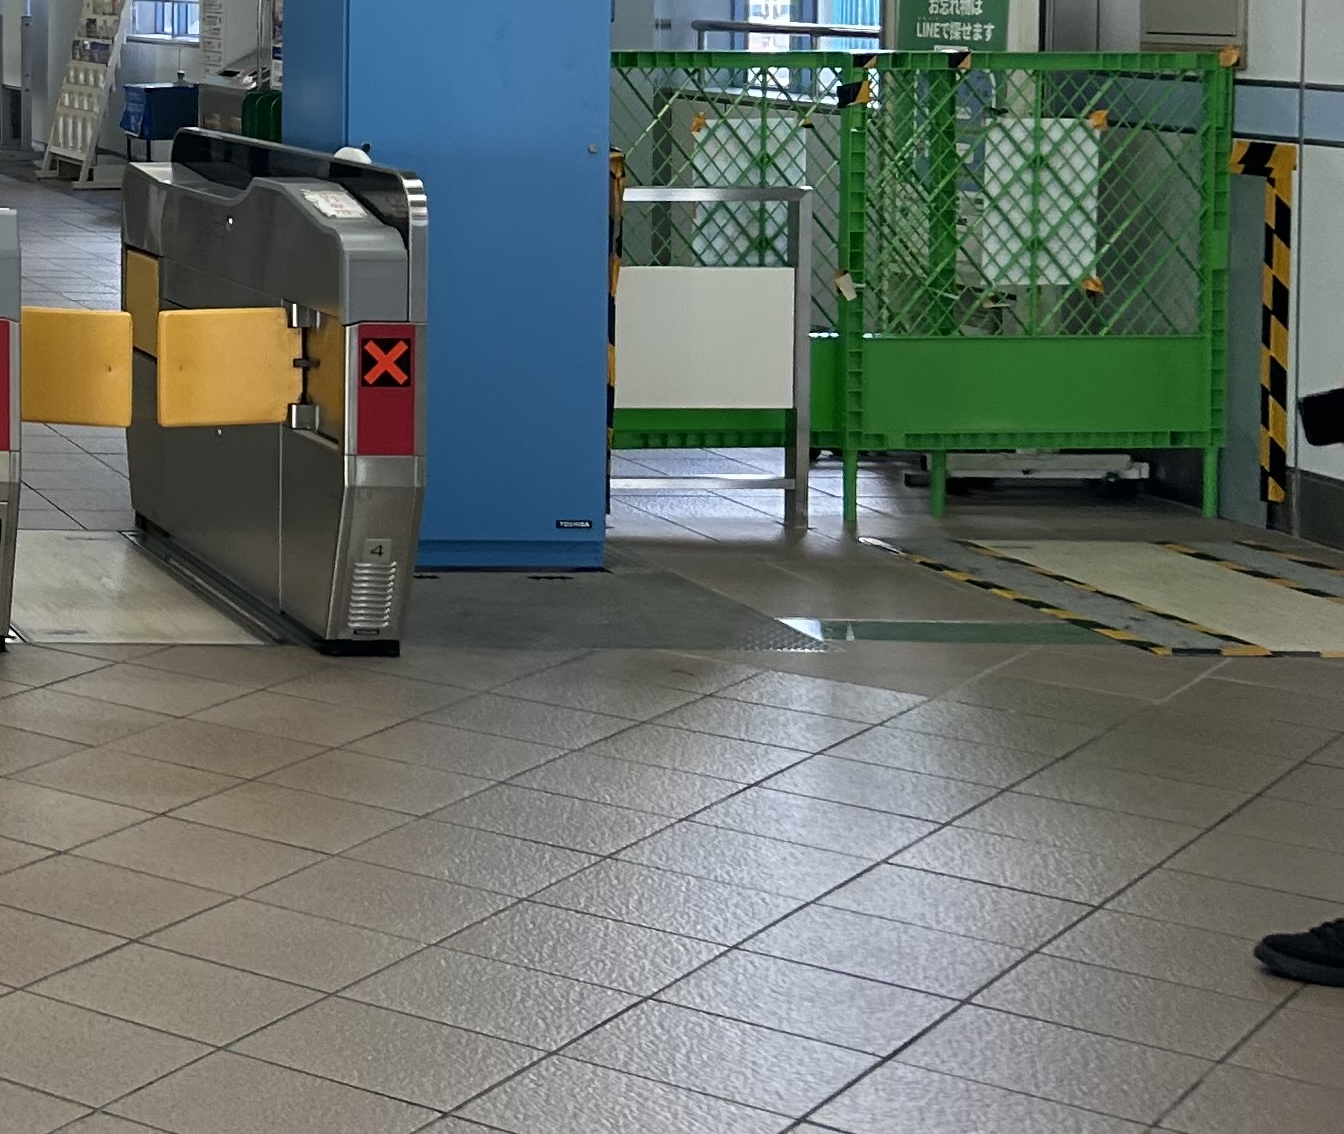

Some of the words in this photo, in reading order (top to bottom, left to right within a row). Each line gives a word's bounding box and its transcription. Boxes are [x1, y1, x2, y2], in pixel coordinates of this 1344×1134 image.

[916, 20, 996, 41] LINEで探せます
[370, 544, 385, 557] 4
